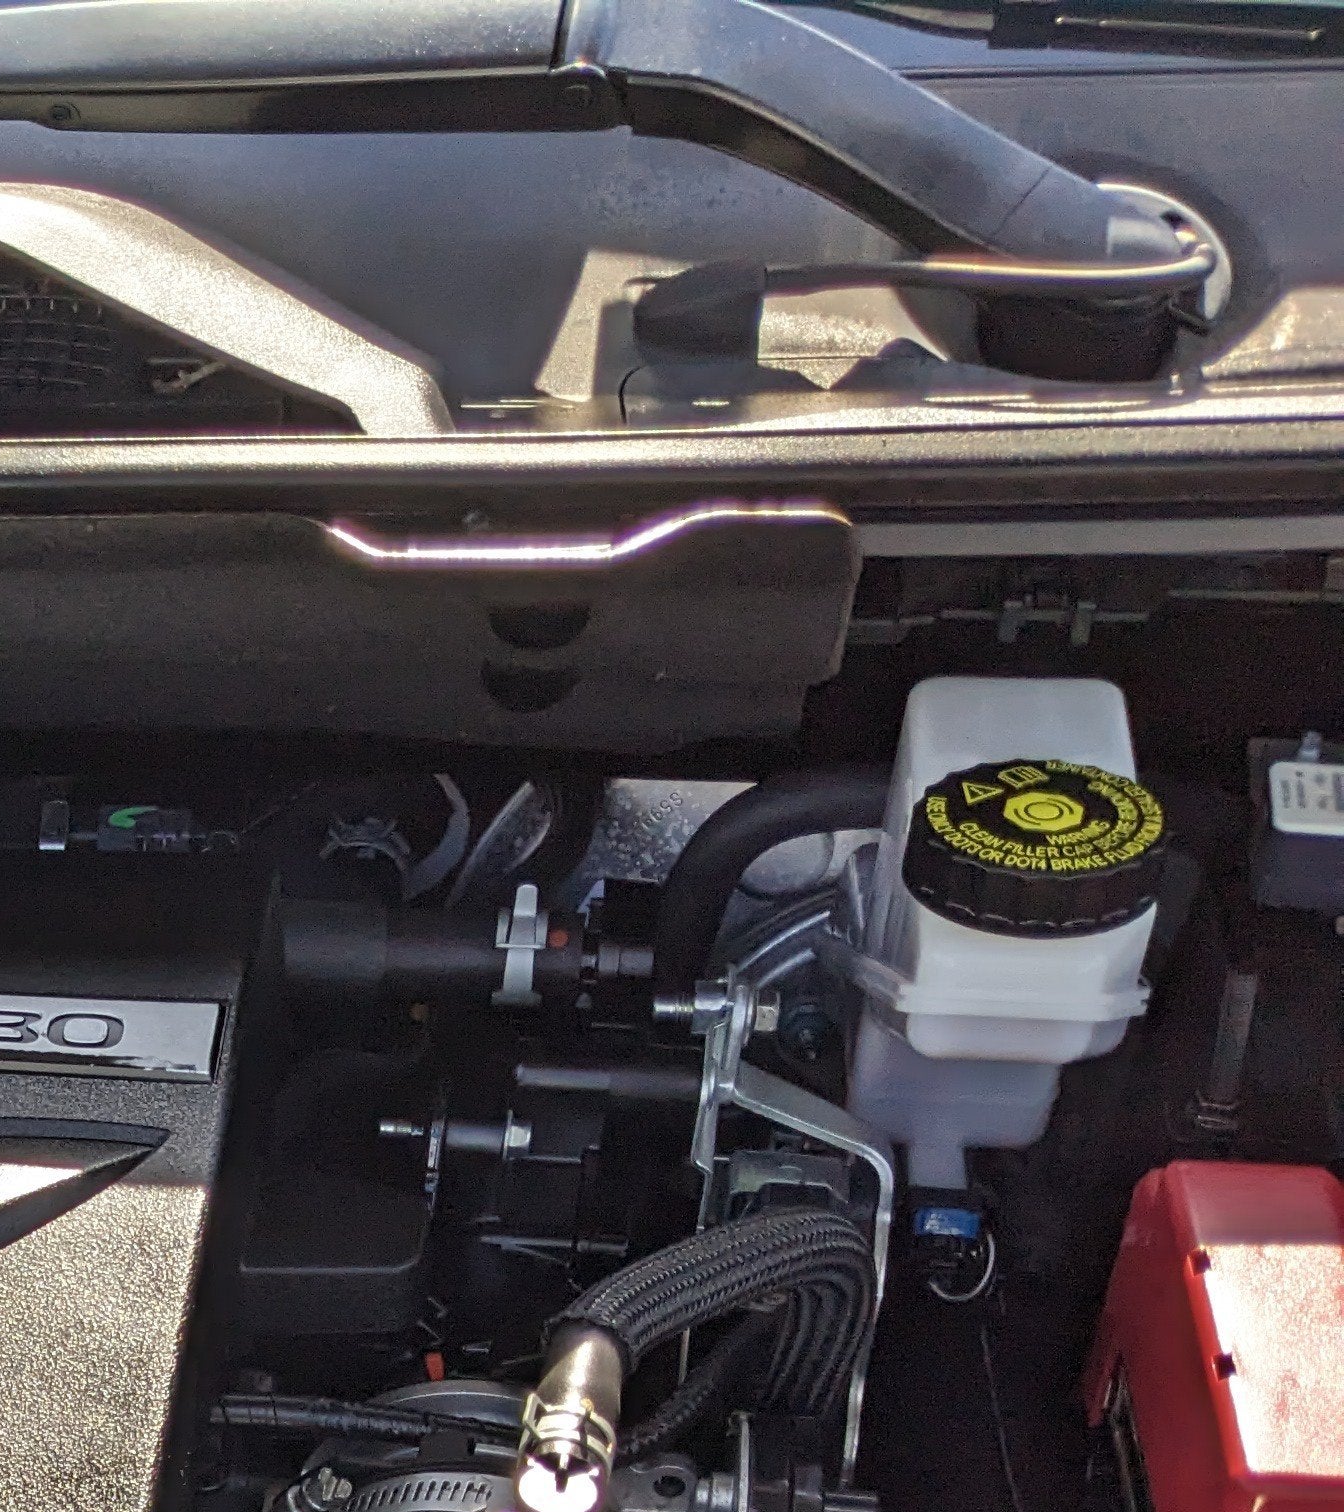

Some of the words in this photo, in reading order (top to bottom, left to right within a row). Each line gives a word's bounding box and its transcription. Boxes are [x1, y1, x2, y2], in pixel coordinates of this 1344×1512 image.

[943, 831, 983, 855] DOT3
[978, 848, 1005, 864] OR
[1004, 854, 1048, 870] DOT4
[1050, 853, 1109, 871] BRAKE
[958, 822, 1005, 849] CLEAN
[1002, 841, 1061, 858] FILLER
